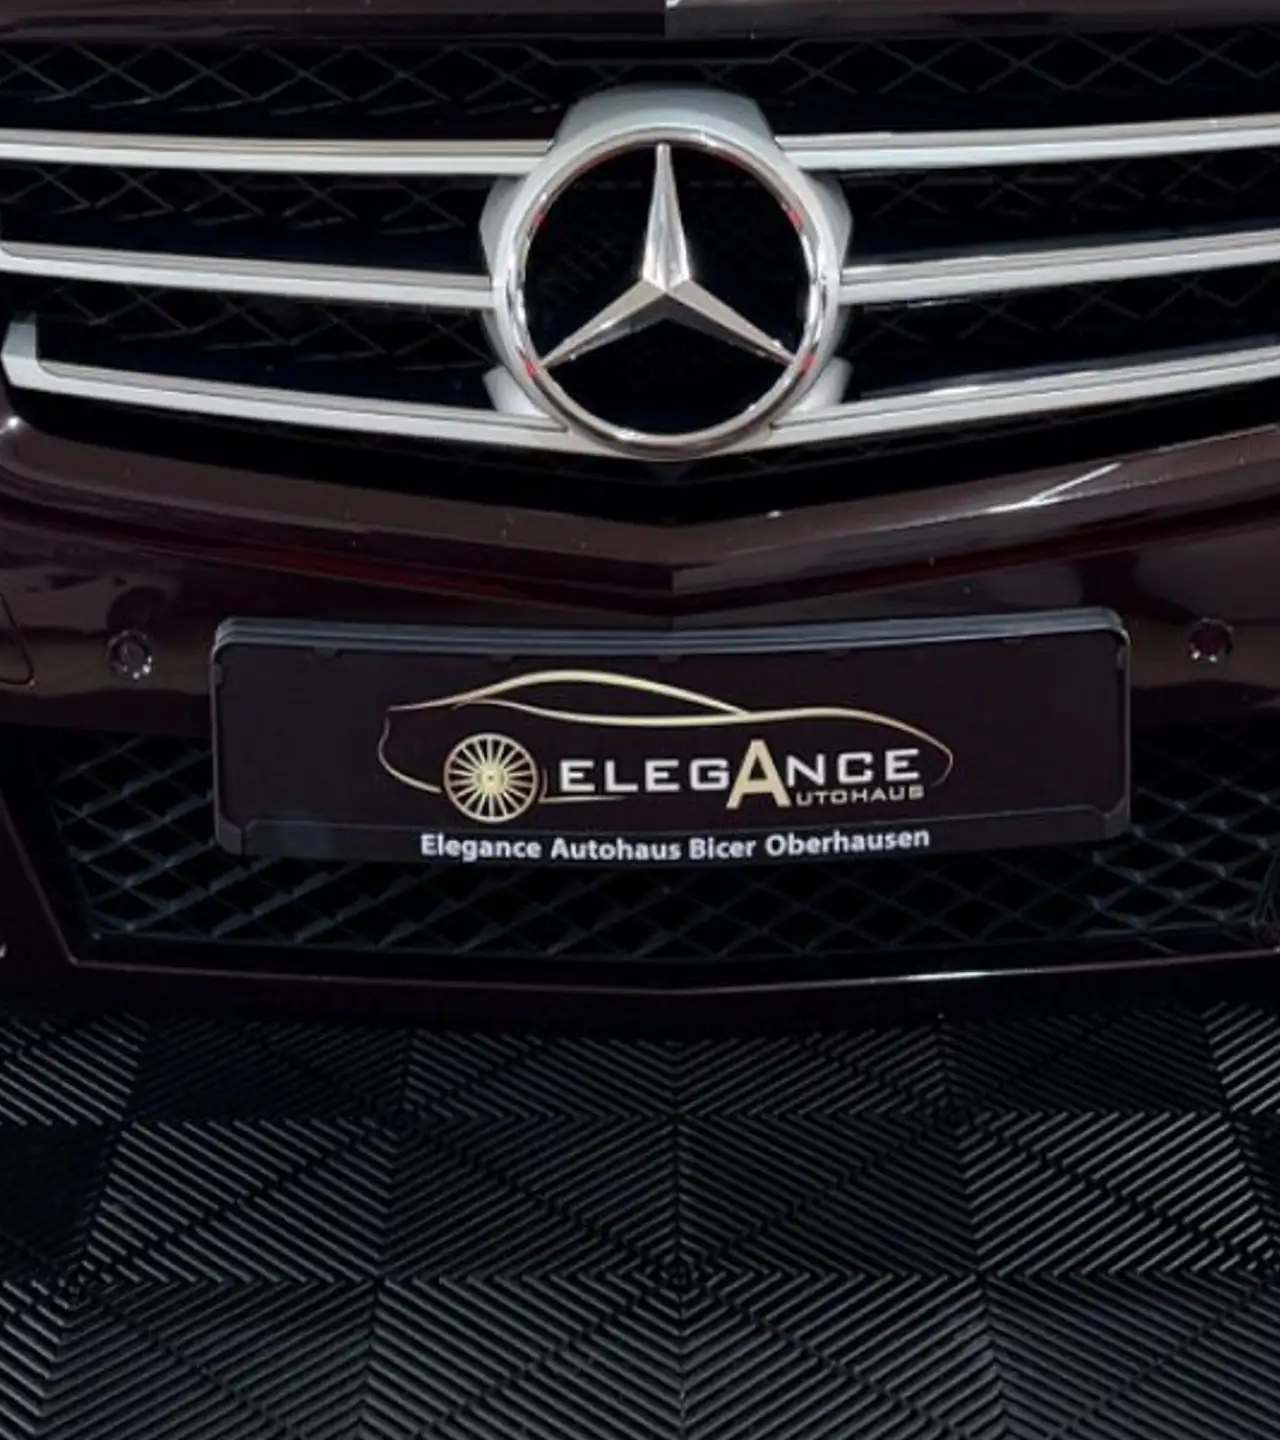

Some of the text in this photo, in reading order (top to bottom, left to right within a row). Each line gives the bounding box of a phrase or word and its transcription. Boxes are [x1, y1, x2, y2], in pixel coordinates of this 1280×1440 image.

[560, 739, 920, 809] ELEGANCE
[420, 829, 930, 861] Elegance Autohaus Bicer Oberhausen
